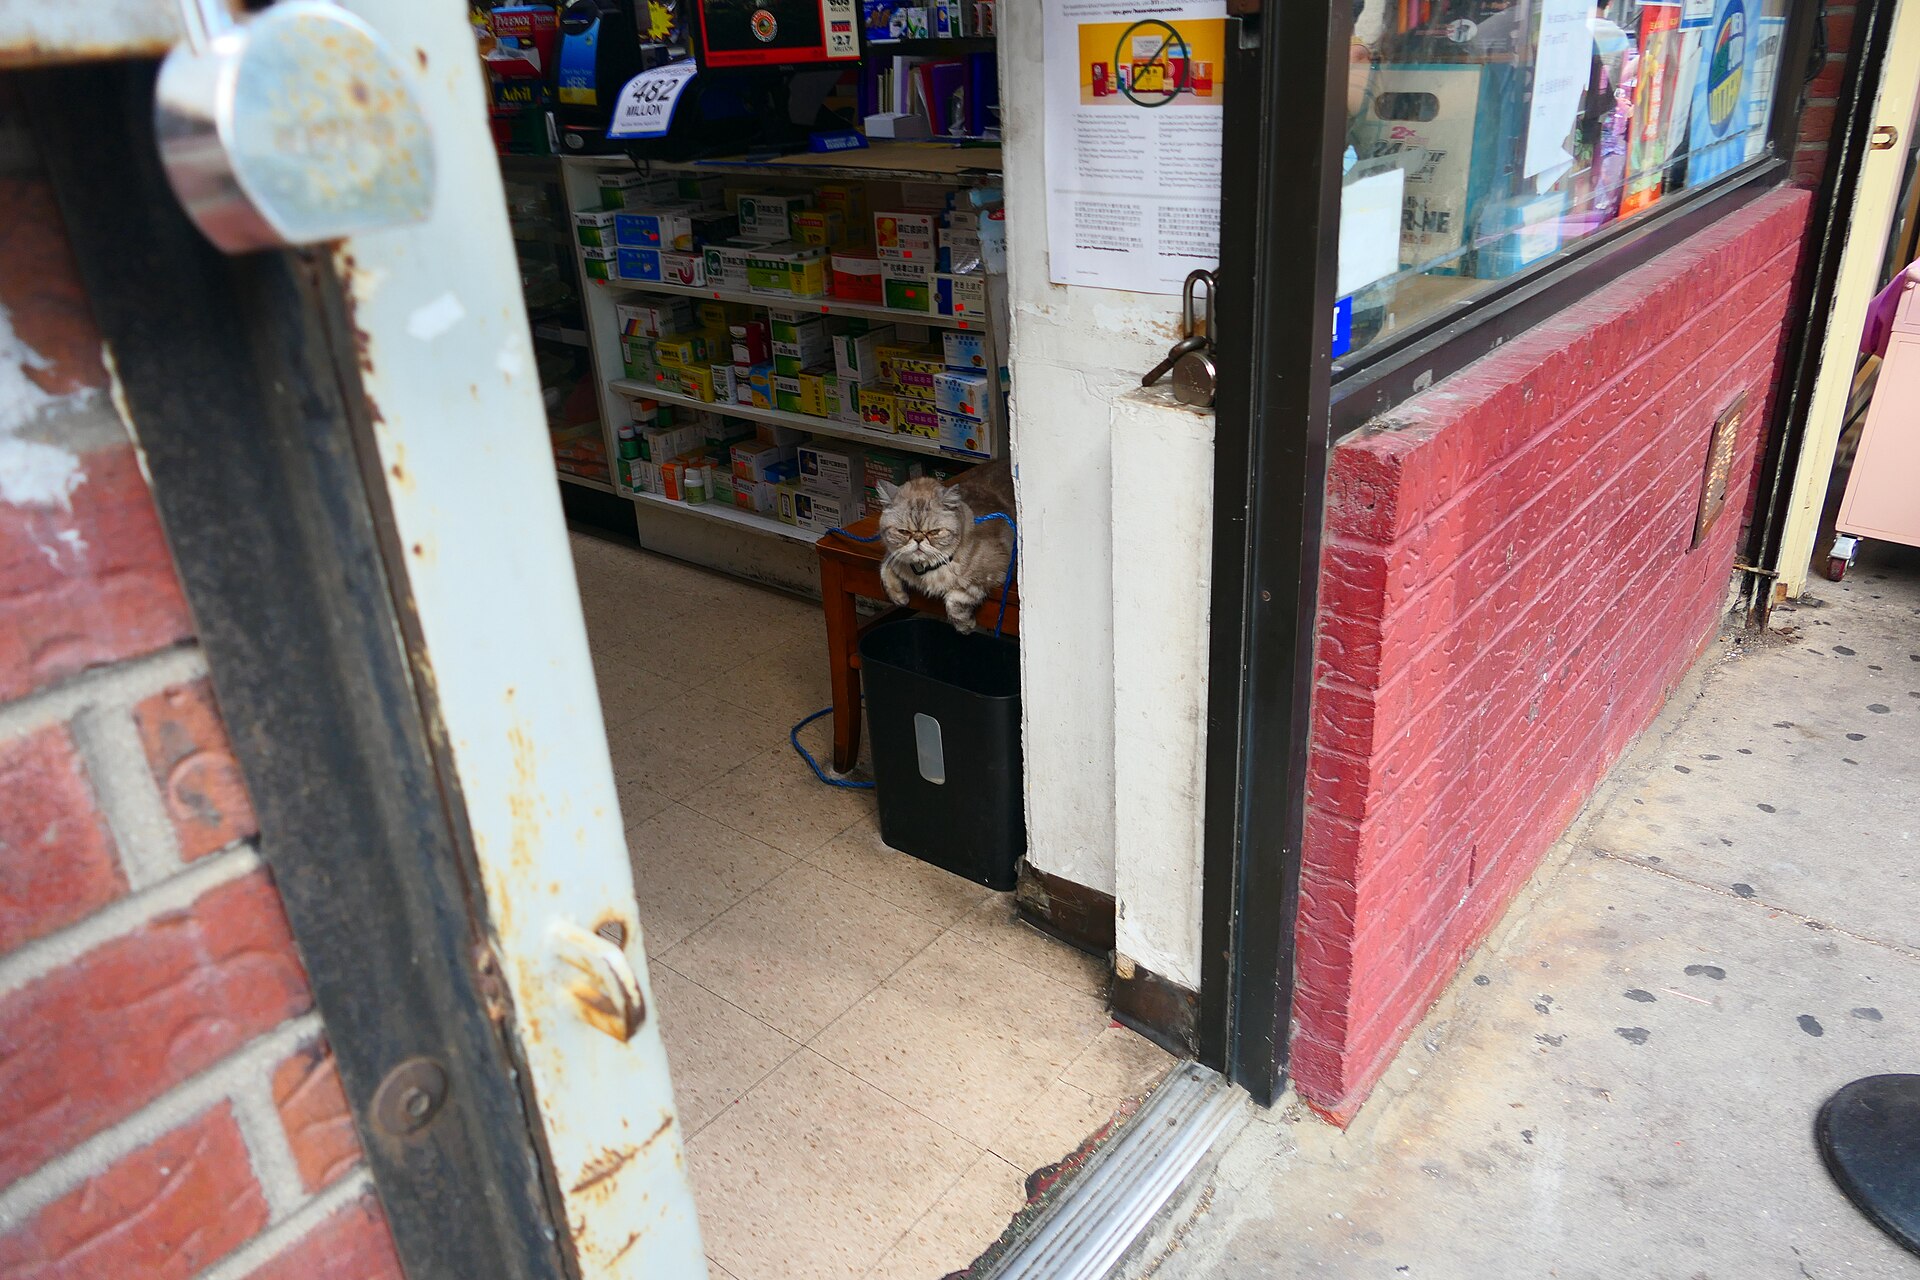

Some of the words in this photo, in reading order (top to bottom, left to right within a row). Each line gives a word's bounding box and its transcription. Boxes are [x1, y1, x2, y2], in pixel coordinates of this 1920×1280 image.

[495, 14, 531, 27] TYLENOL
[503, 86, 531, 102] Advil
[626, 104, 663, 117] MILLION
